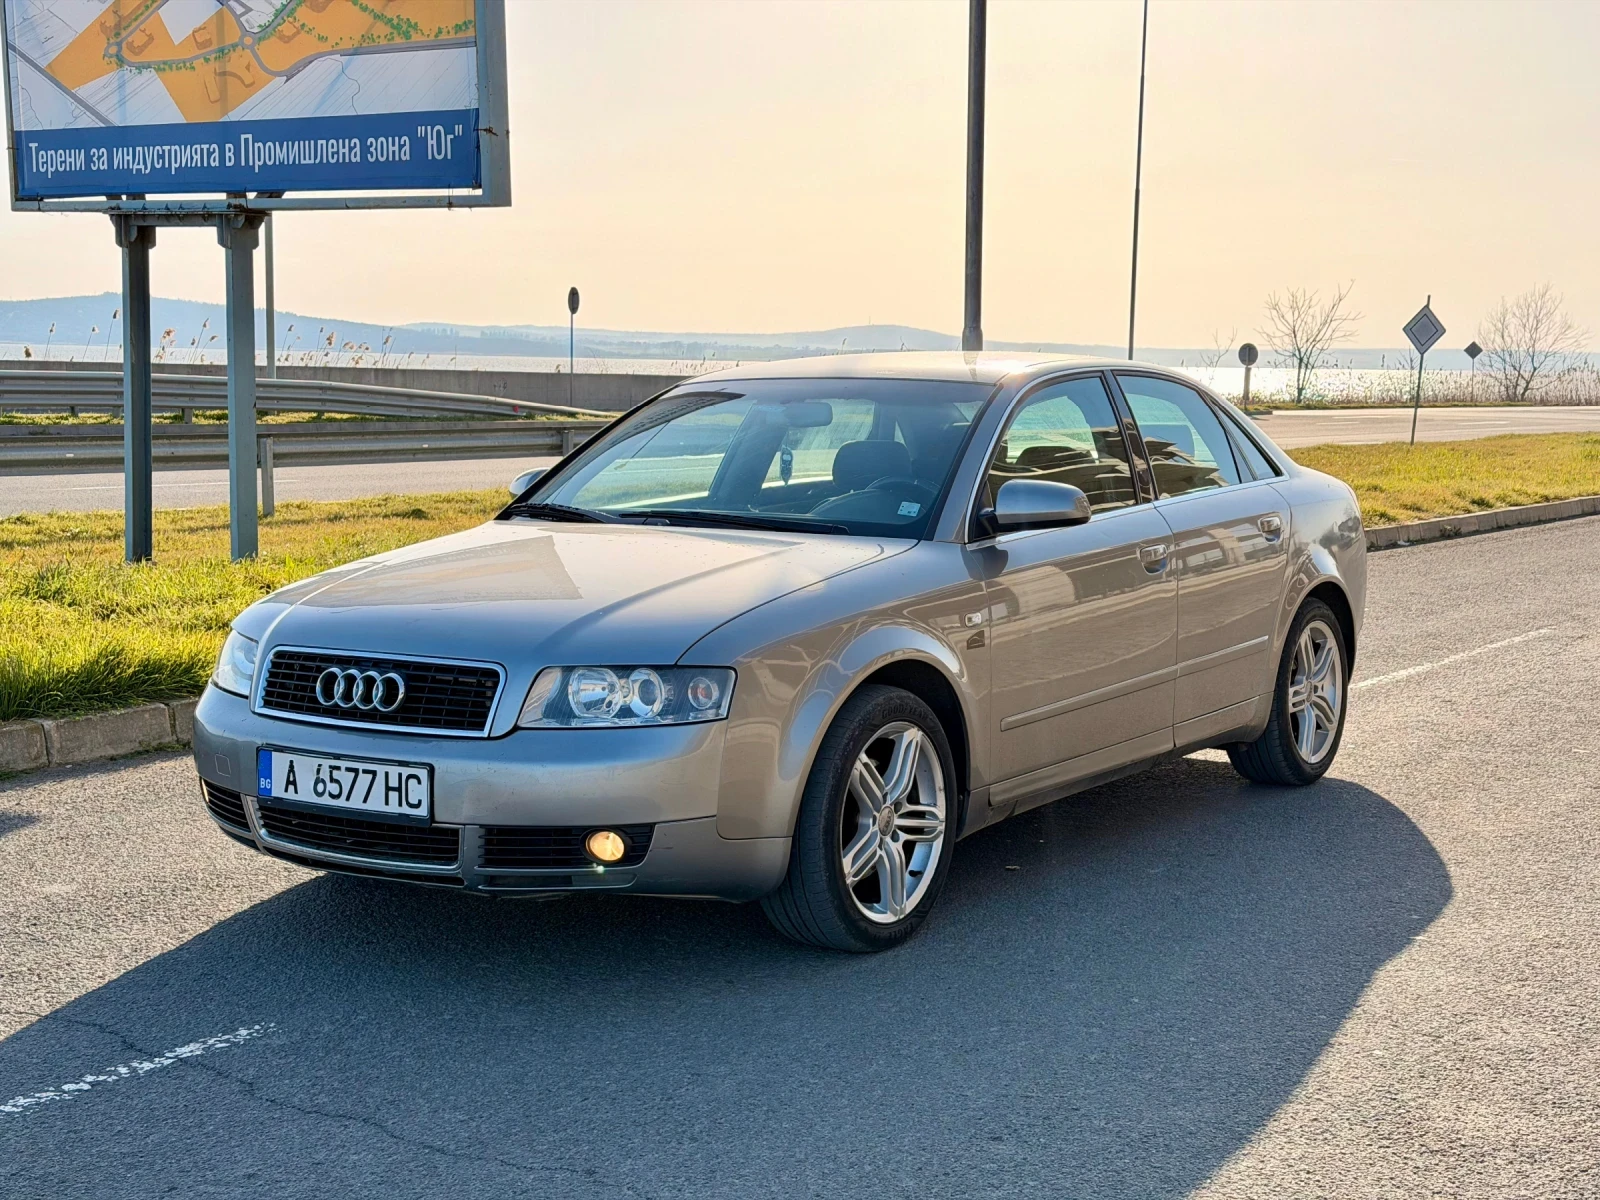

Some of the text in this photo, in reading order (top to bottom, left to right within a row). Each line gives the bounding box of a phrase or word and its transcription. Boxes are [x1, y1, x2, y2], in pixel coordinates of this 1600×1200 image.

[28, 124, 463, 178] Терени за индустрията в Промишлена зона "Юг"
[260, 777, 271, 789] BG
[283, 759, 422, 809] A 6577 HC
